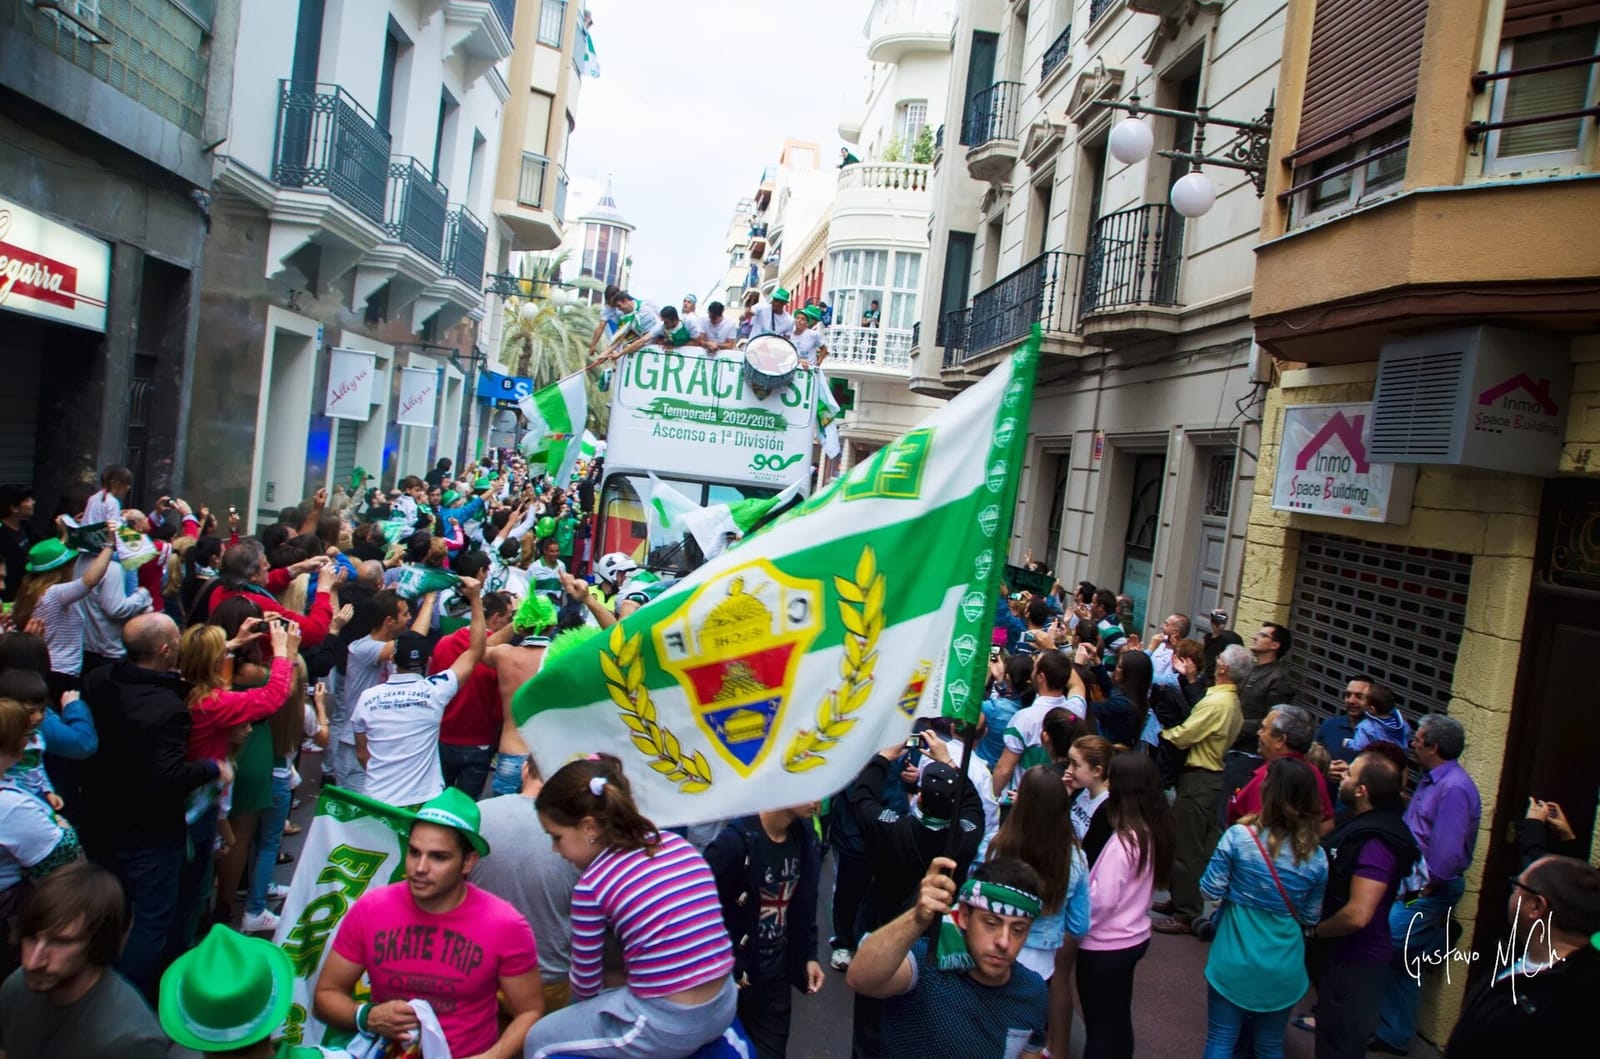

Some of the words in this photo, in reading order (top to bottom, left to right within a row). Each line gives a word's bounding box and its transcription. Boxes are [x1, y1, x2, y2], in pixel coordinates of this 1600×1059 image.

[0, 254, 64, 305] egarra
[624, 348, 813, 409] ¡GRACIS!
[662, 403, 717, 422] Temporada
[723, 410, 775, 427] 2012/2013
[1475, 412, 1511, 426] Space
[1503, 396, 1541, 413] Inmo
[653, 422, 705, 442] Ascenso
[709, 432, 717, 444] a
[735, 432, 784, 451] División
[1315, 452, 1350, 473] Inmo
[1289, 474, 1320, 497] Space
[1323, 477, 1368, 505] Building
[373, 925, 438, 966] SKATE
[440, 928, 484, 977] TRIP
